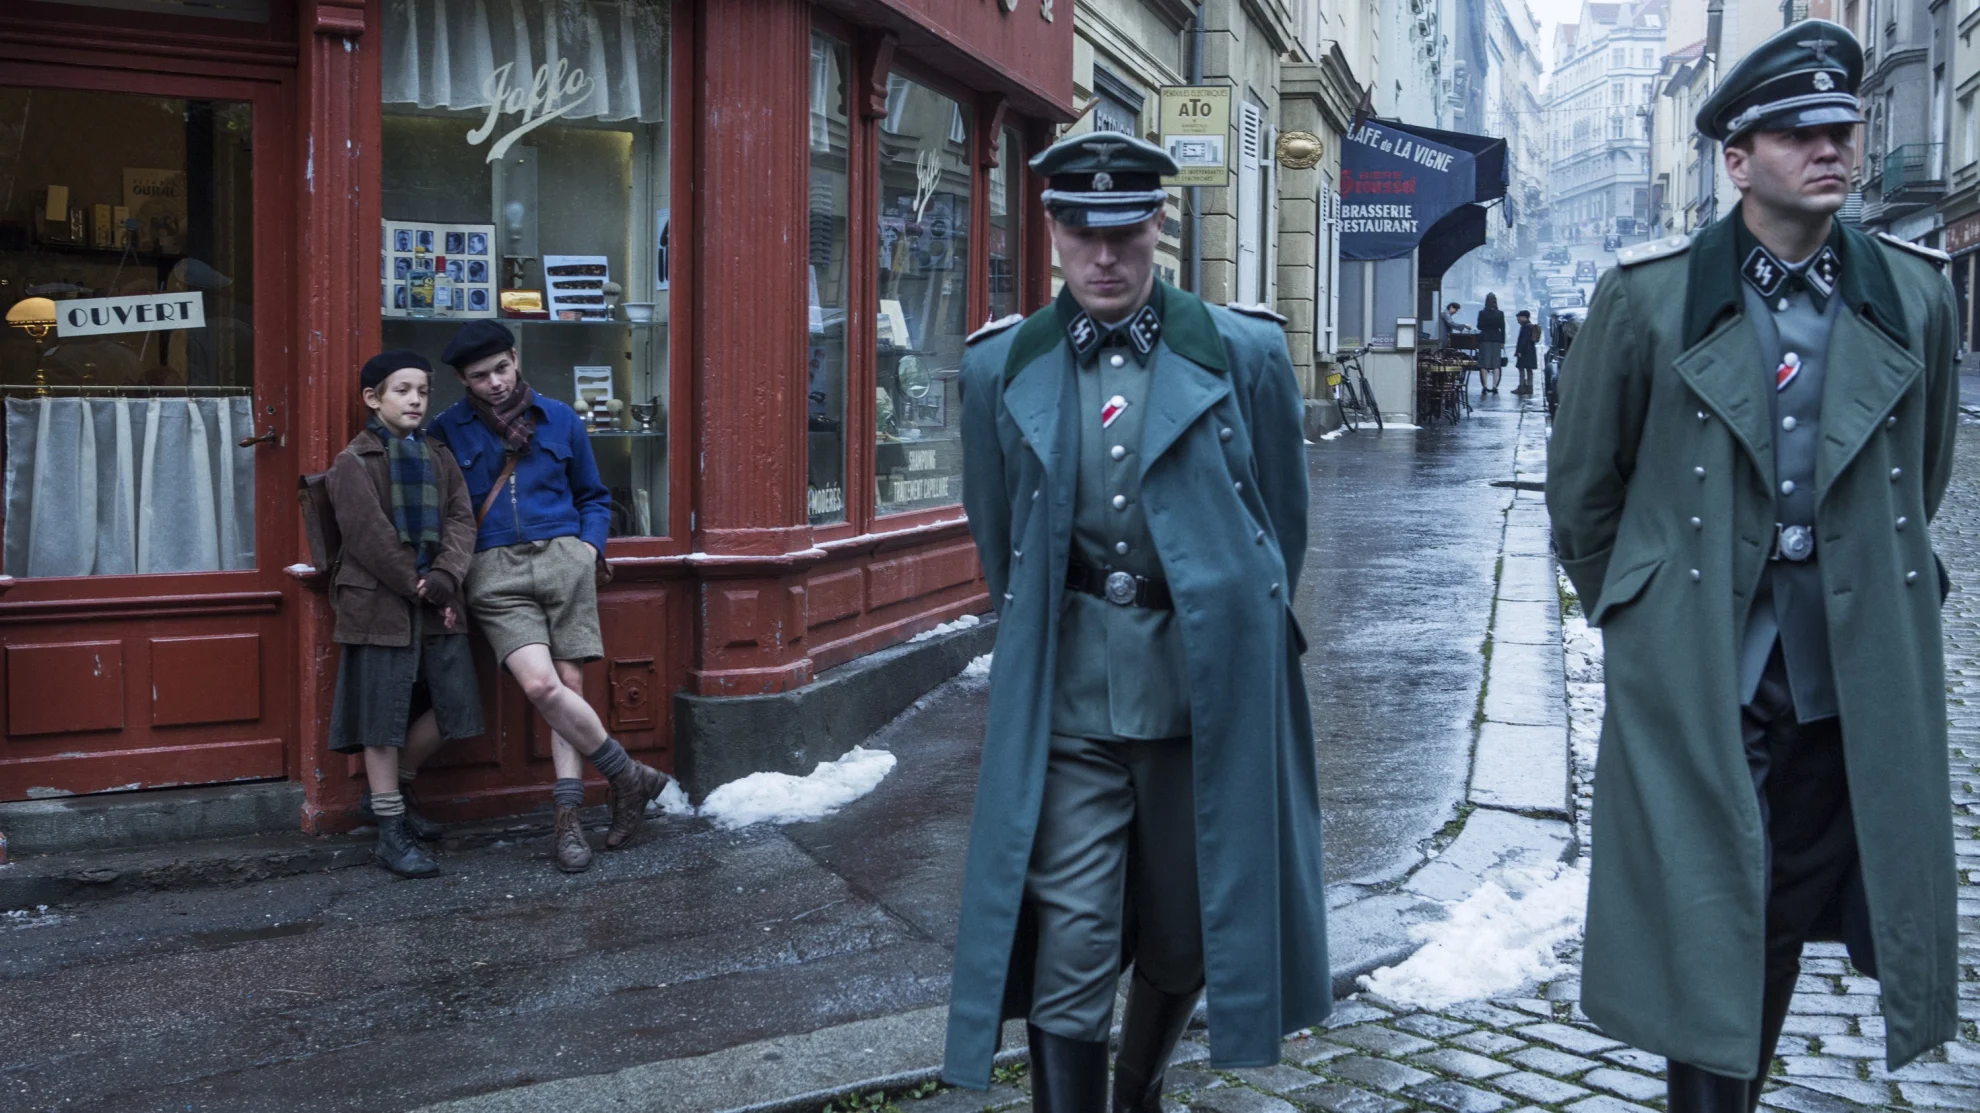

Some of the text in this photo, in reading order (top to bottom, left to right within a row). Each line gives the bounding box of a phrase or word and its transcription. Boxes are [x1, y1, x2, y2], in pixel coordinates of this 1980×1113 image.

[1178, 98, 1212, 117] ATO
[1346, 122, 1454, 173] CAFE de LA VIGNE
[1341, 204, 1412, 218] BRASSERIE
[1338, 219, 1419, 233] RESTAURANT
[67, 300, 194, 328] OUVERT
